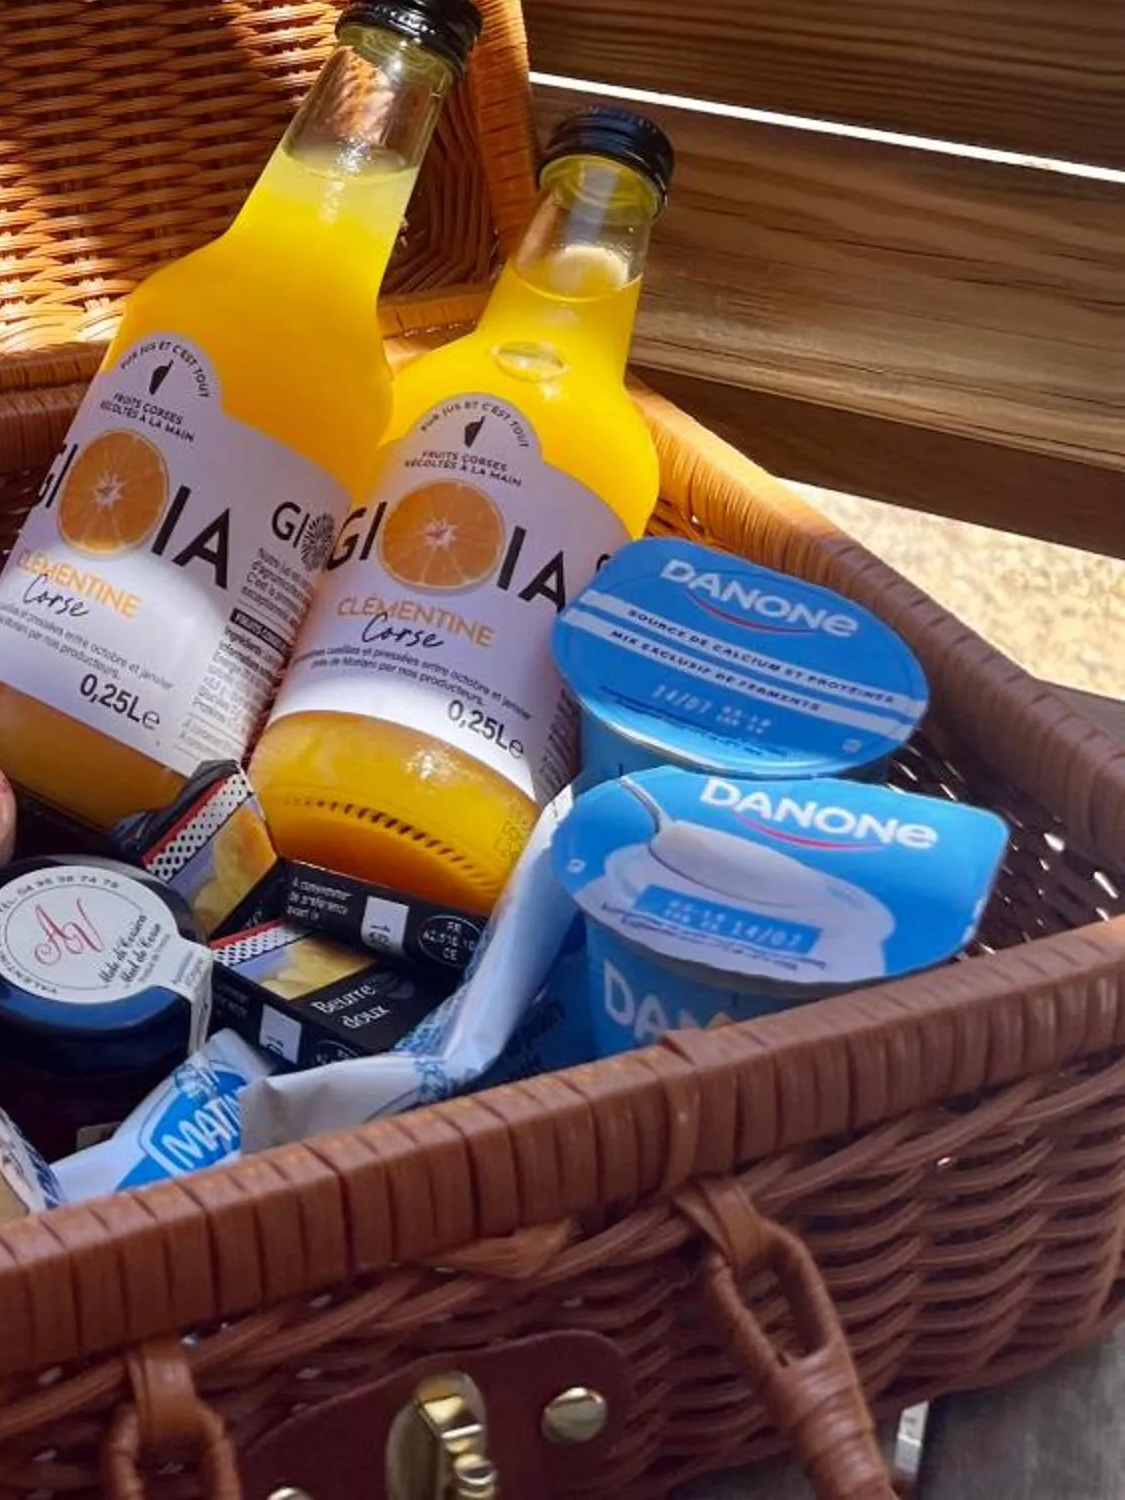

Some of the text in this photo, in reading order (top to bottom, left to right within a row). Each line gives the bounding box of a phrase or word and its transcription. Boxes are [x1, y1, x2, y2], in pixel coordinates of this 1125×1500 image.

[159, 341, 171, 351] ET
[193, 368, 209, 397] TOUT
[143, 404, 183, 425] CORSES
[443, 403, 460, 416] JUS
[465, 401, 479, 409] ET
[482, 402, 511, 420] C'EST
[509, 420, 529, 447] TOUT
[149, 417, 161, 428] LA
[165, 423, 194, 442] MAIN
[422, 451, 507, 472] FRUITS CORSES
[471, 466, 486, 475] LA
[490, 471, 522, 487] MAIN
[22, 573, 89, 617] Corse
[362, 612, 444, 649] Corse
[628, 609, 685, 637] SOURCE
[689, 635, 707, 647] DE
[712, 643, 781, 671] CALCIUM
[784, 668, 804, 679] ET
[399, 666, 418, 680] nos
[450, 669, 490, 695] octobre
[609, 629, 821, 711] MIX EXCLUSIF DE FERMENTS
[732, 920, 803, 948] 14/07
[442, 947, 459, 961] CE
[310, 983, 377, 1014] Beurre
[341, 1005, 390, 1029] doux
